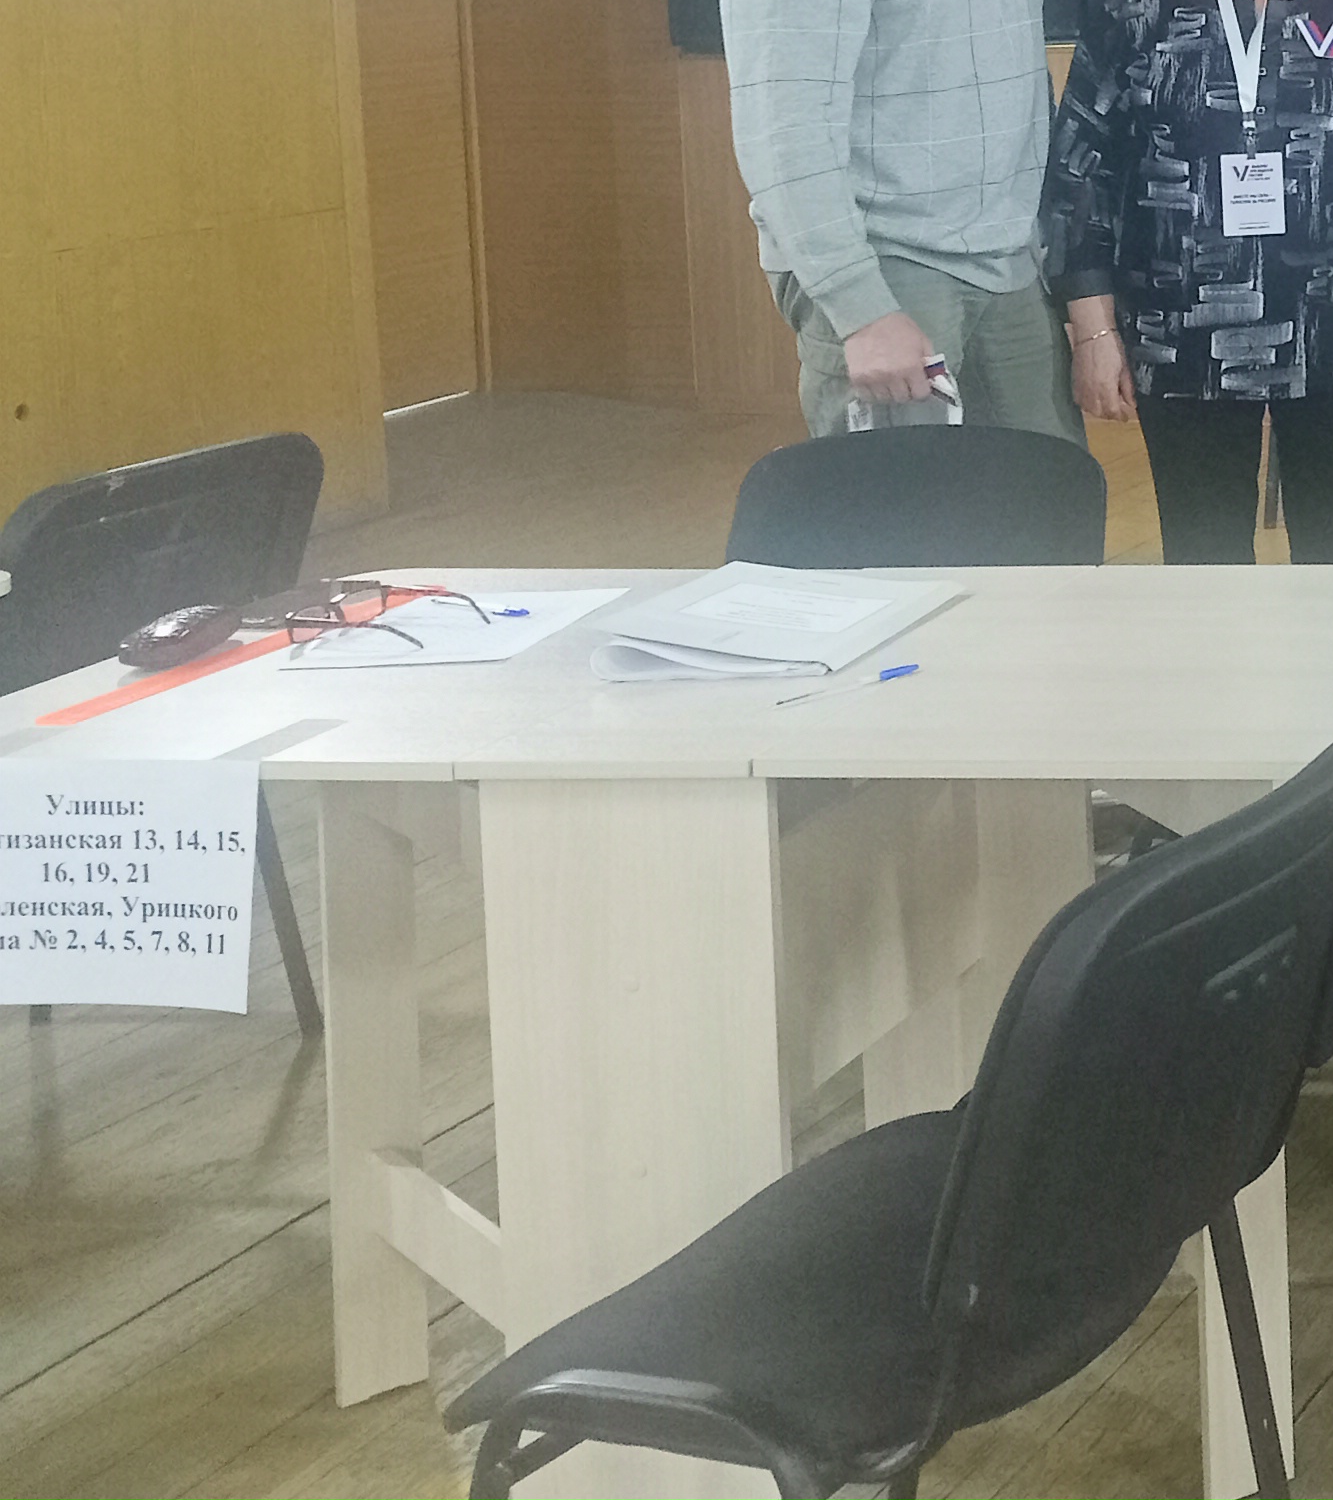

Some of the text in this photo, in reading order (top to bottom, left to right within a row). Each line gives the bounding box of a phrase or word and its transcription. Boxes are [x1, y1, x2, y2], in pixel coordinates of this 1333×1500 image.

[46, 794, 145, 817] Улицы:
[133, 828, 165, 853] 13,
[175, 829, 208, 854] 14,
[217, 830, 246, 855] 15,
[42, 861, 150, 886] 16, 19, 21
[120, 895, 239, 924] Урицкого
[28, 929, 58, 951] №
[66, 928, 87, 953] 2,
[93, 928, 116, 953] 4,
[122, 929, 143, 954] 5,
[150, 930, 171, 955] 7,
[177, 930, 197, 957] 8,
[205, 932, 225, 955] 11
